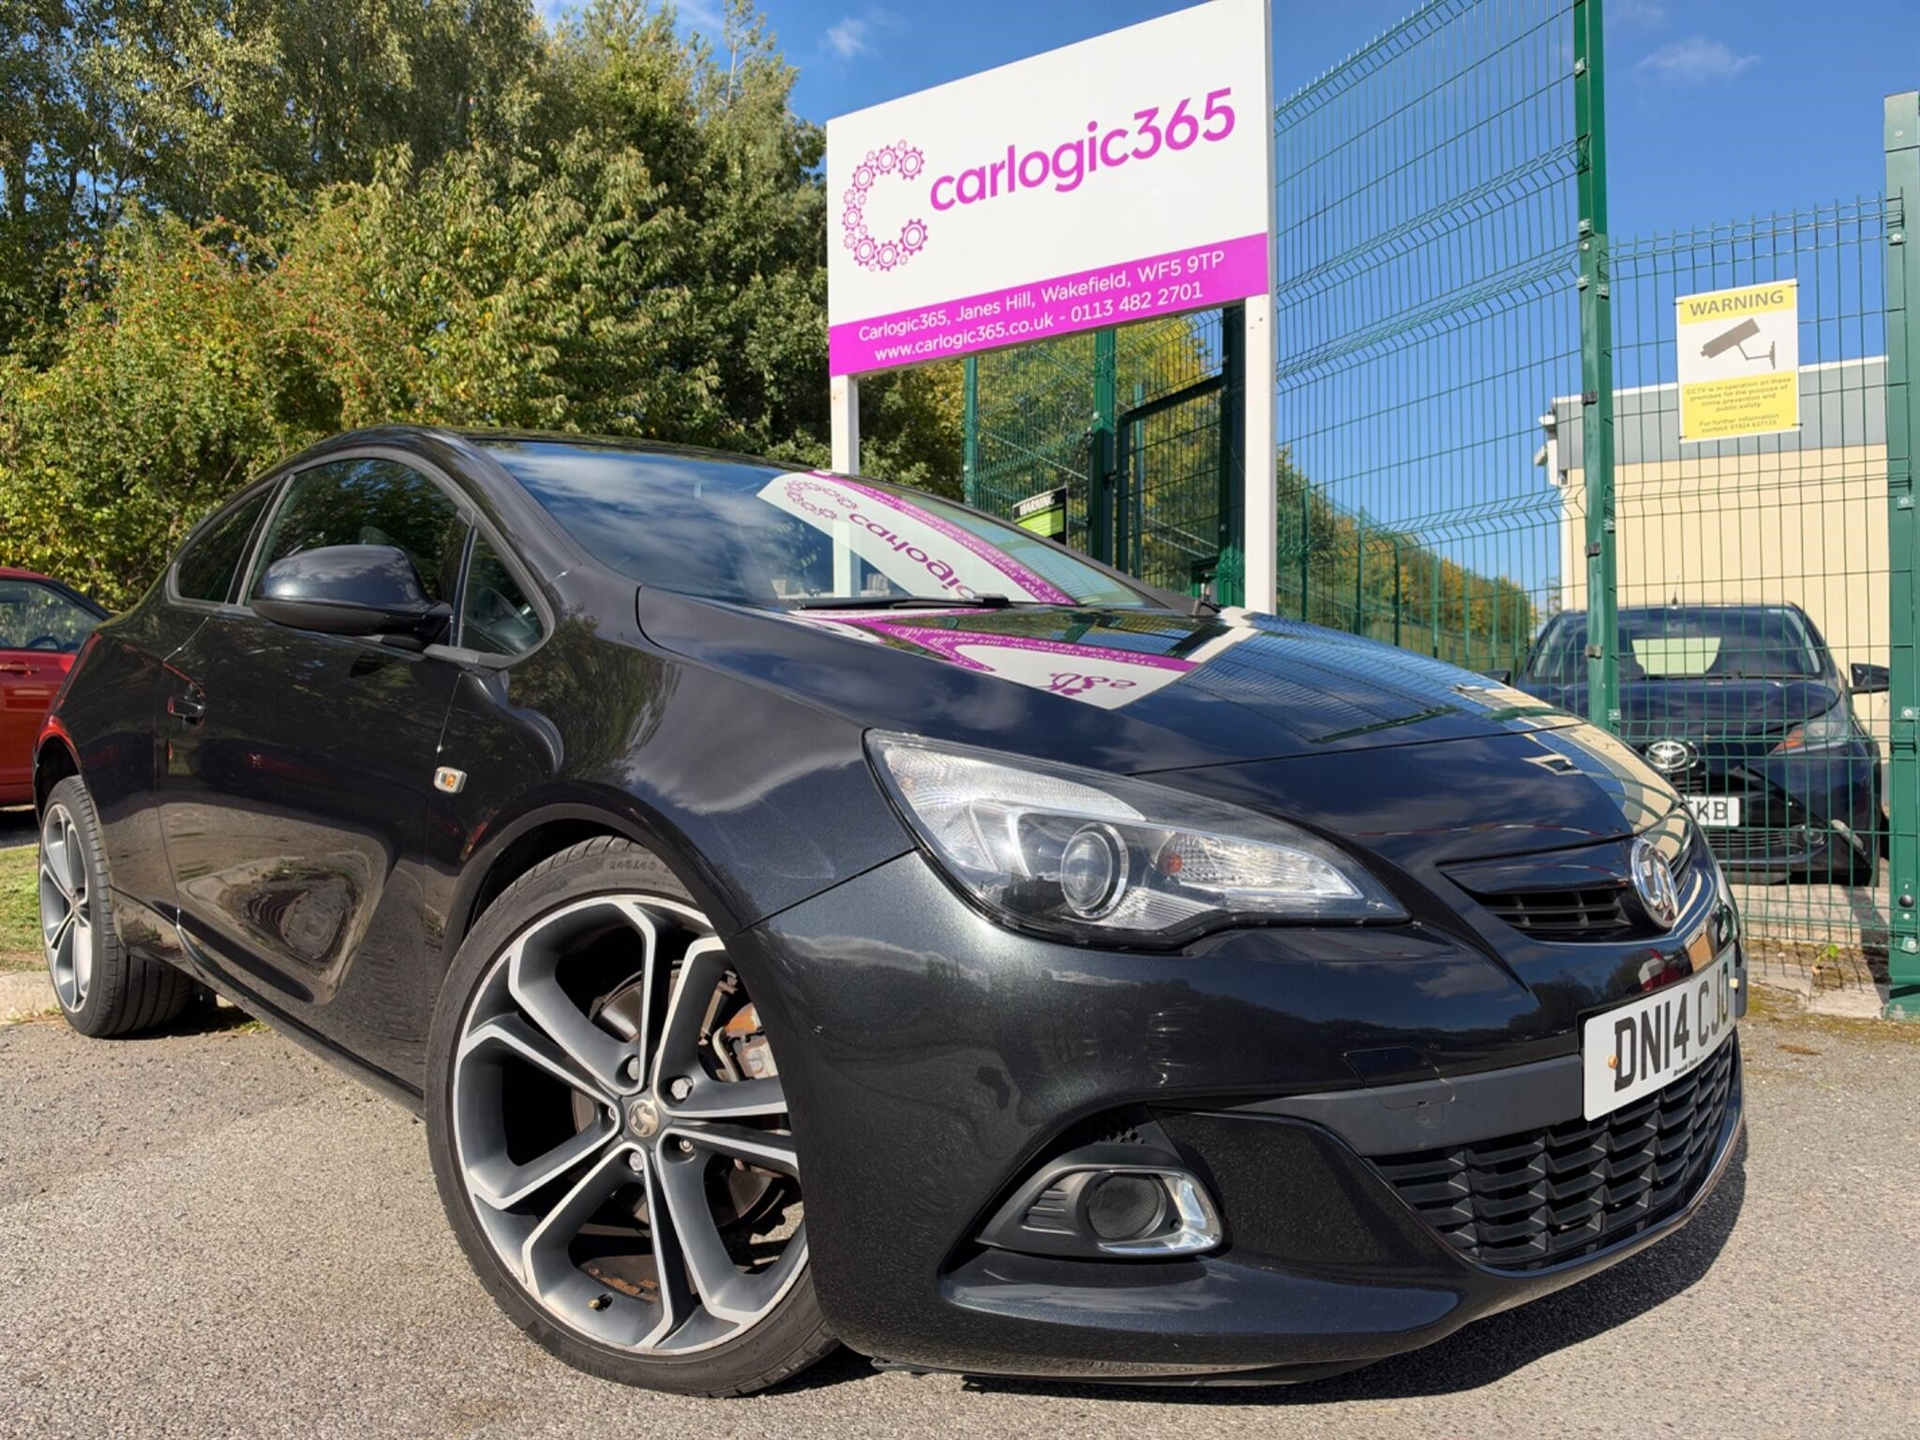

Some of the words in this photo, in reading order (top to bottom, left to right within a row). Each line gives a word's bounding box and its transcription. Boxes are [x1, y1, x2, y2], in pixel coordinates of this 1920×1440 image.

[930, 87, 1235, 211] carlogic365
[858, 310, 951, 342] Carlogic365,
[956, 301, 1000, 322] Janes
[1006, 291, 1036, 312] Hill,
[1041, 270, 1131, 303] Wakefield,
[1137, 259, 1182, 284] WF5
[1187, 250, 1225, 273] 9TP
[875, 312, 1054, 361] www.carlogic365.co.uk
[1071, 299, 1113, 322] 0113
[1118, 292, 1152, 312] 482
[1157, 281, 1203, 306] 2701
[1690, 290, 1784, 316] WARNING
[1688, 801, 1728, 820] KB
[1615, 993, 1690, 1093] DN14
[1697, 962, 1729, 1047] CJO
